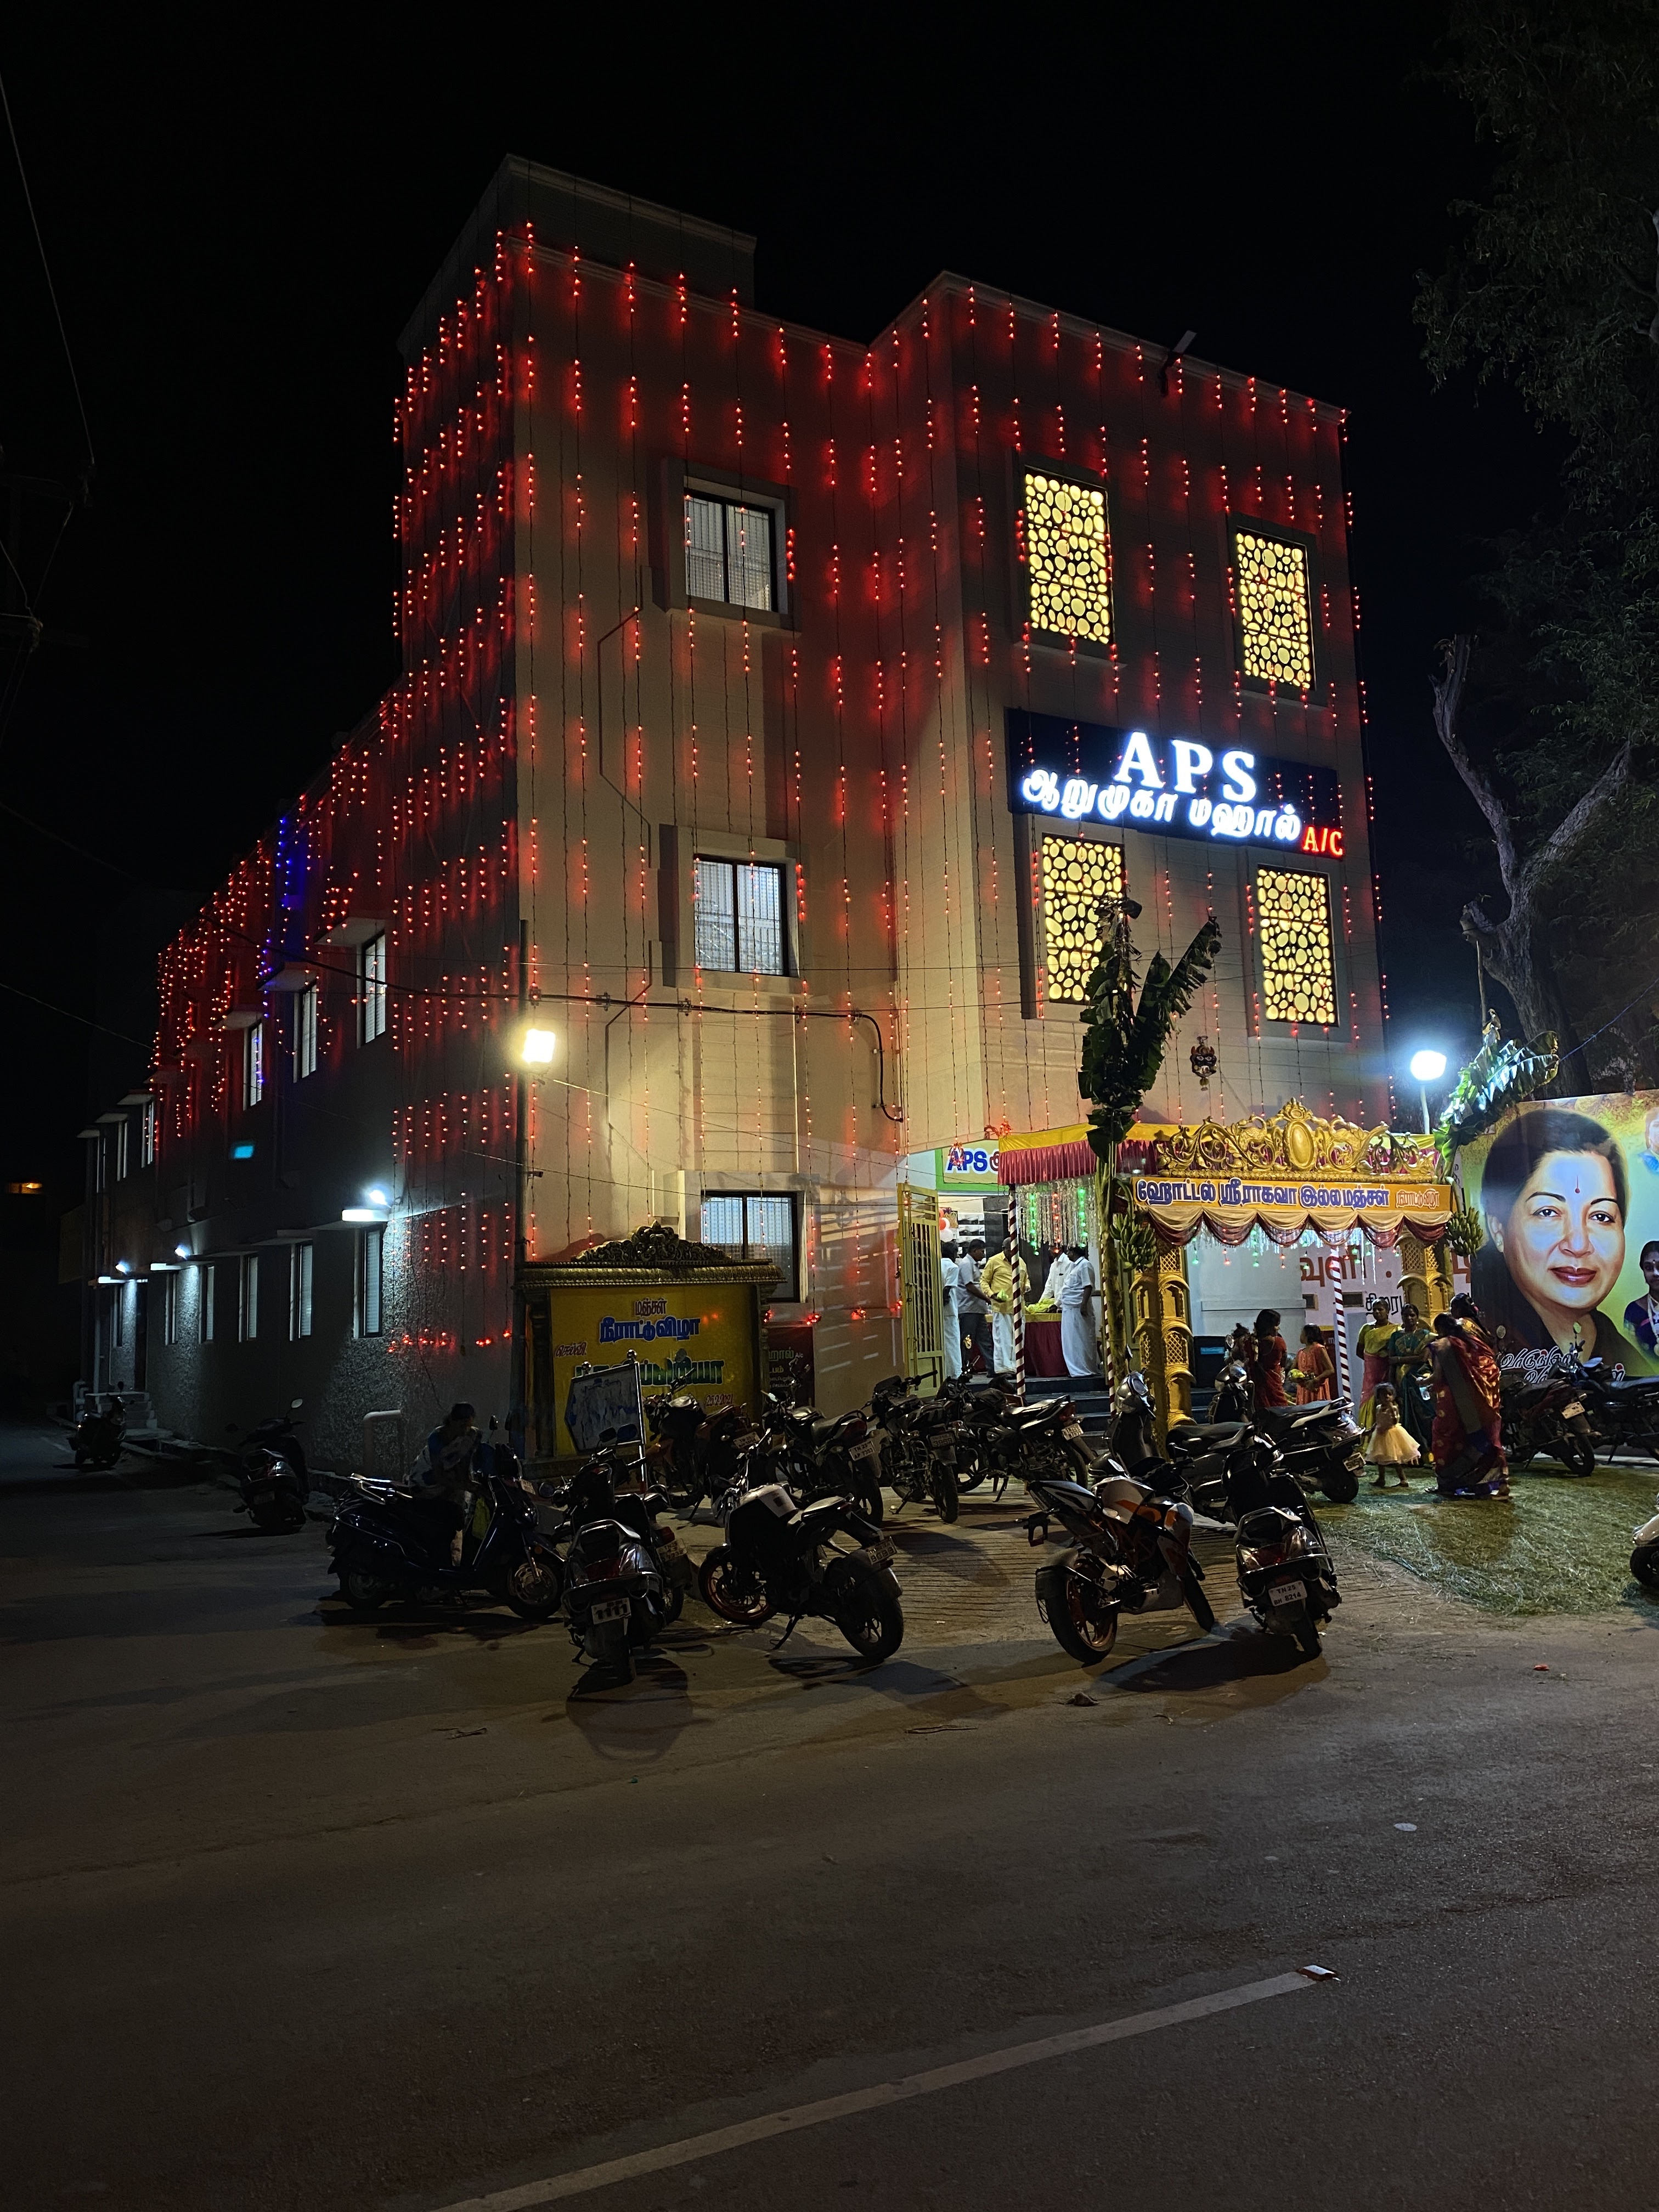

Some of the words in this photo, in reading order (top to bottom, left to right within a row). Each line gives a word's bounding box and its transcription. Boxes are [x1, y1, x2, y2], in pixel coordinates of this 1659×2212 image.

[1114, 731, 1257, 803] APS
[1022, 769, 1178, 820] ஆறுமுகா
[1189, 799, 1301, 840] மஹால்
[1303, 826, 1342, 856] A/C
[947, 1150, 988, 1171] APS
[1138, 1178, 1216, 1205] ஹோட்டல்
[634, 1297, 667, 1317] மஞ்சள்
[1284, 1592, 1301, 1601] 8214
